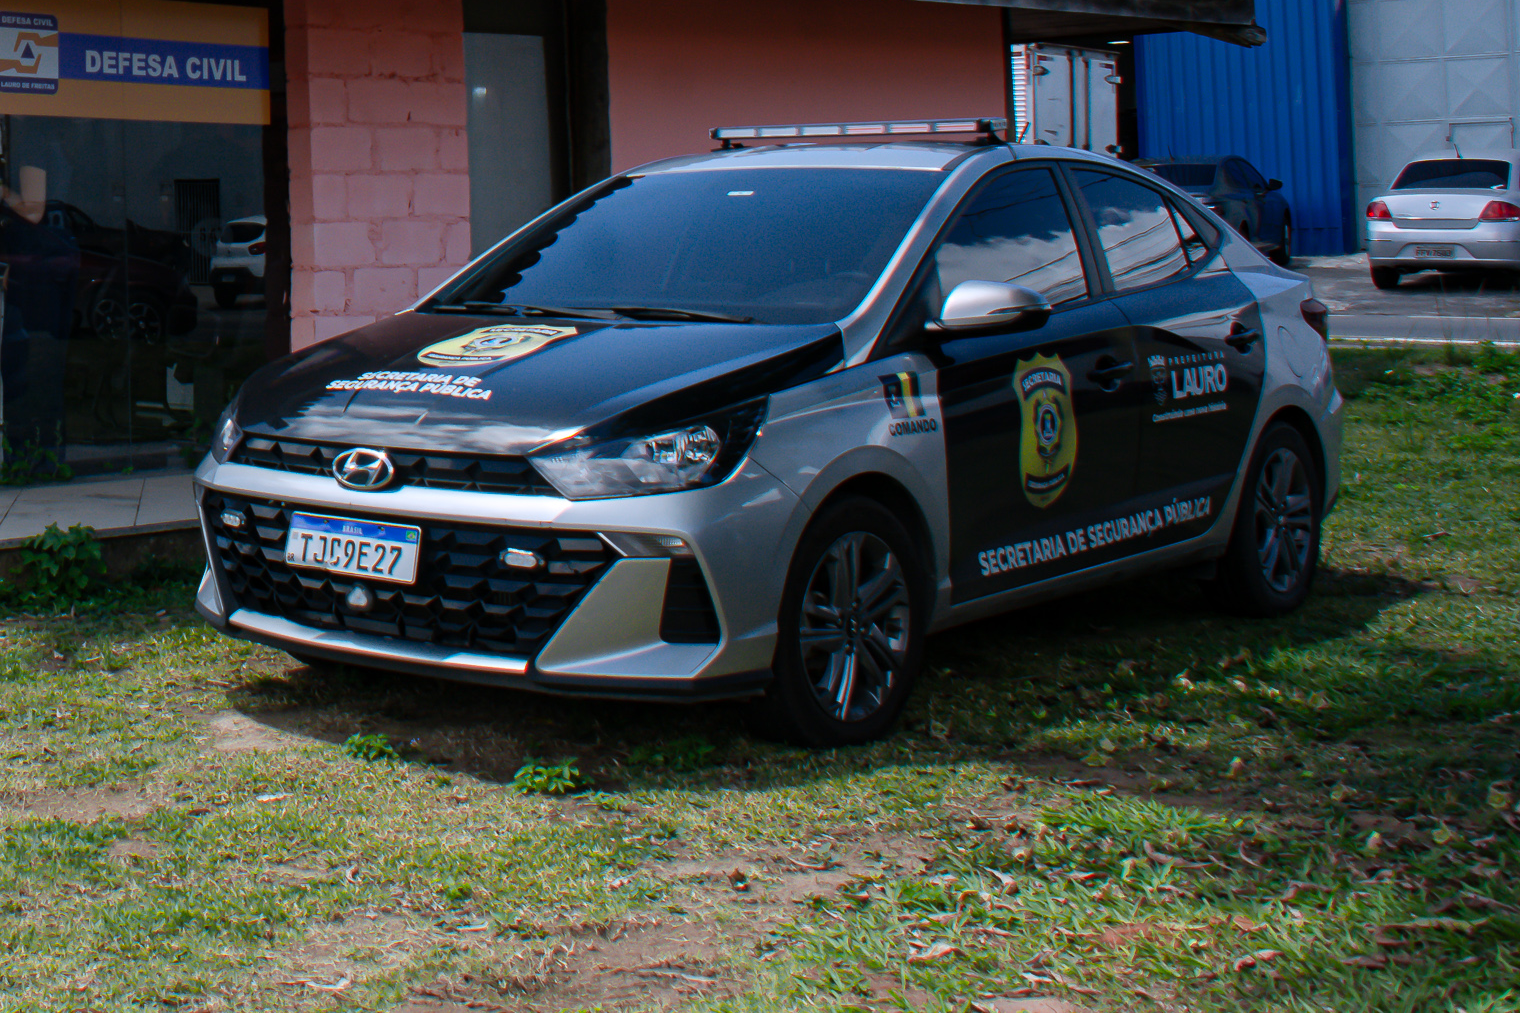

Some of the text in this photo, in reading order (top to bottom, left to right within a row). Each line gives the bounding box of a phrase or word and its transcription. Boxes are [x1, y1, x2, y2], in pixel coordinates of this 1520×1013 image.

[1, 15, 54, 27] DEFESA CIVIL
[85, 49, 247, 82] DEFESA CIVIL
[1167, 350, 1225, 366] PREFEITURA
[325, 379, 420, 393] SEGURANÇA
[357, 371, 482, 387] SECRETARIA DE
[1021, 371, 1063, 393] SECRETARIA
[1171, 363, 1228, 399] LAURO
[888, 418, 938, 436] COMANDO
[342, 524, 364, 535] BRASIL
[977, 496, 1212, 577] SECRETARIA DE SEGURANÇA PÚBLICA
[300, 532, 403, 576] TJC9E27
